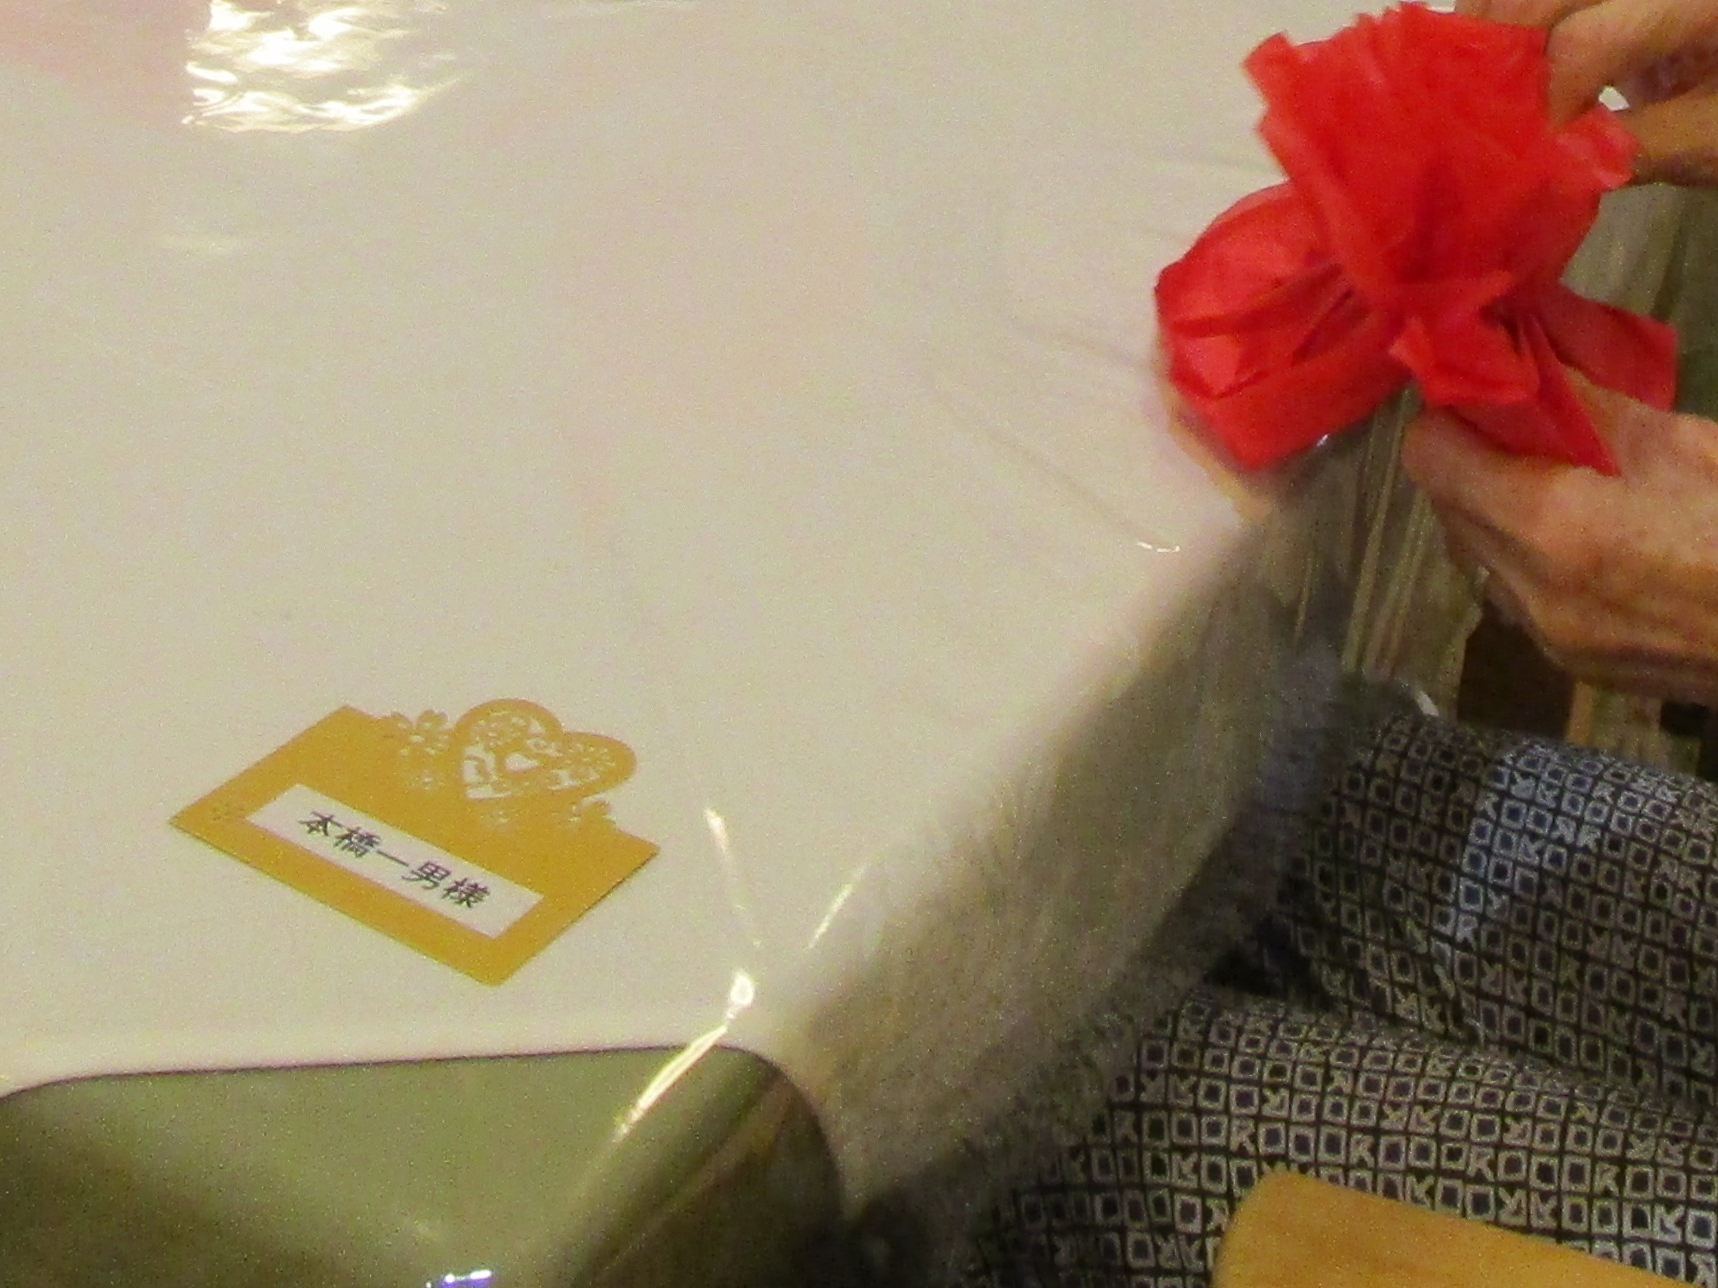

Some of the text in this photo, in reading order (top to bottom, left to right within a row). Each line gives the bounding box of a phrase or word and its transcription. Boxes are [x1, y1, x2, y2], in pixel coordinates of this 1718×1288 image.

[297, 809, 491, 910] 本橋一男様
